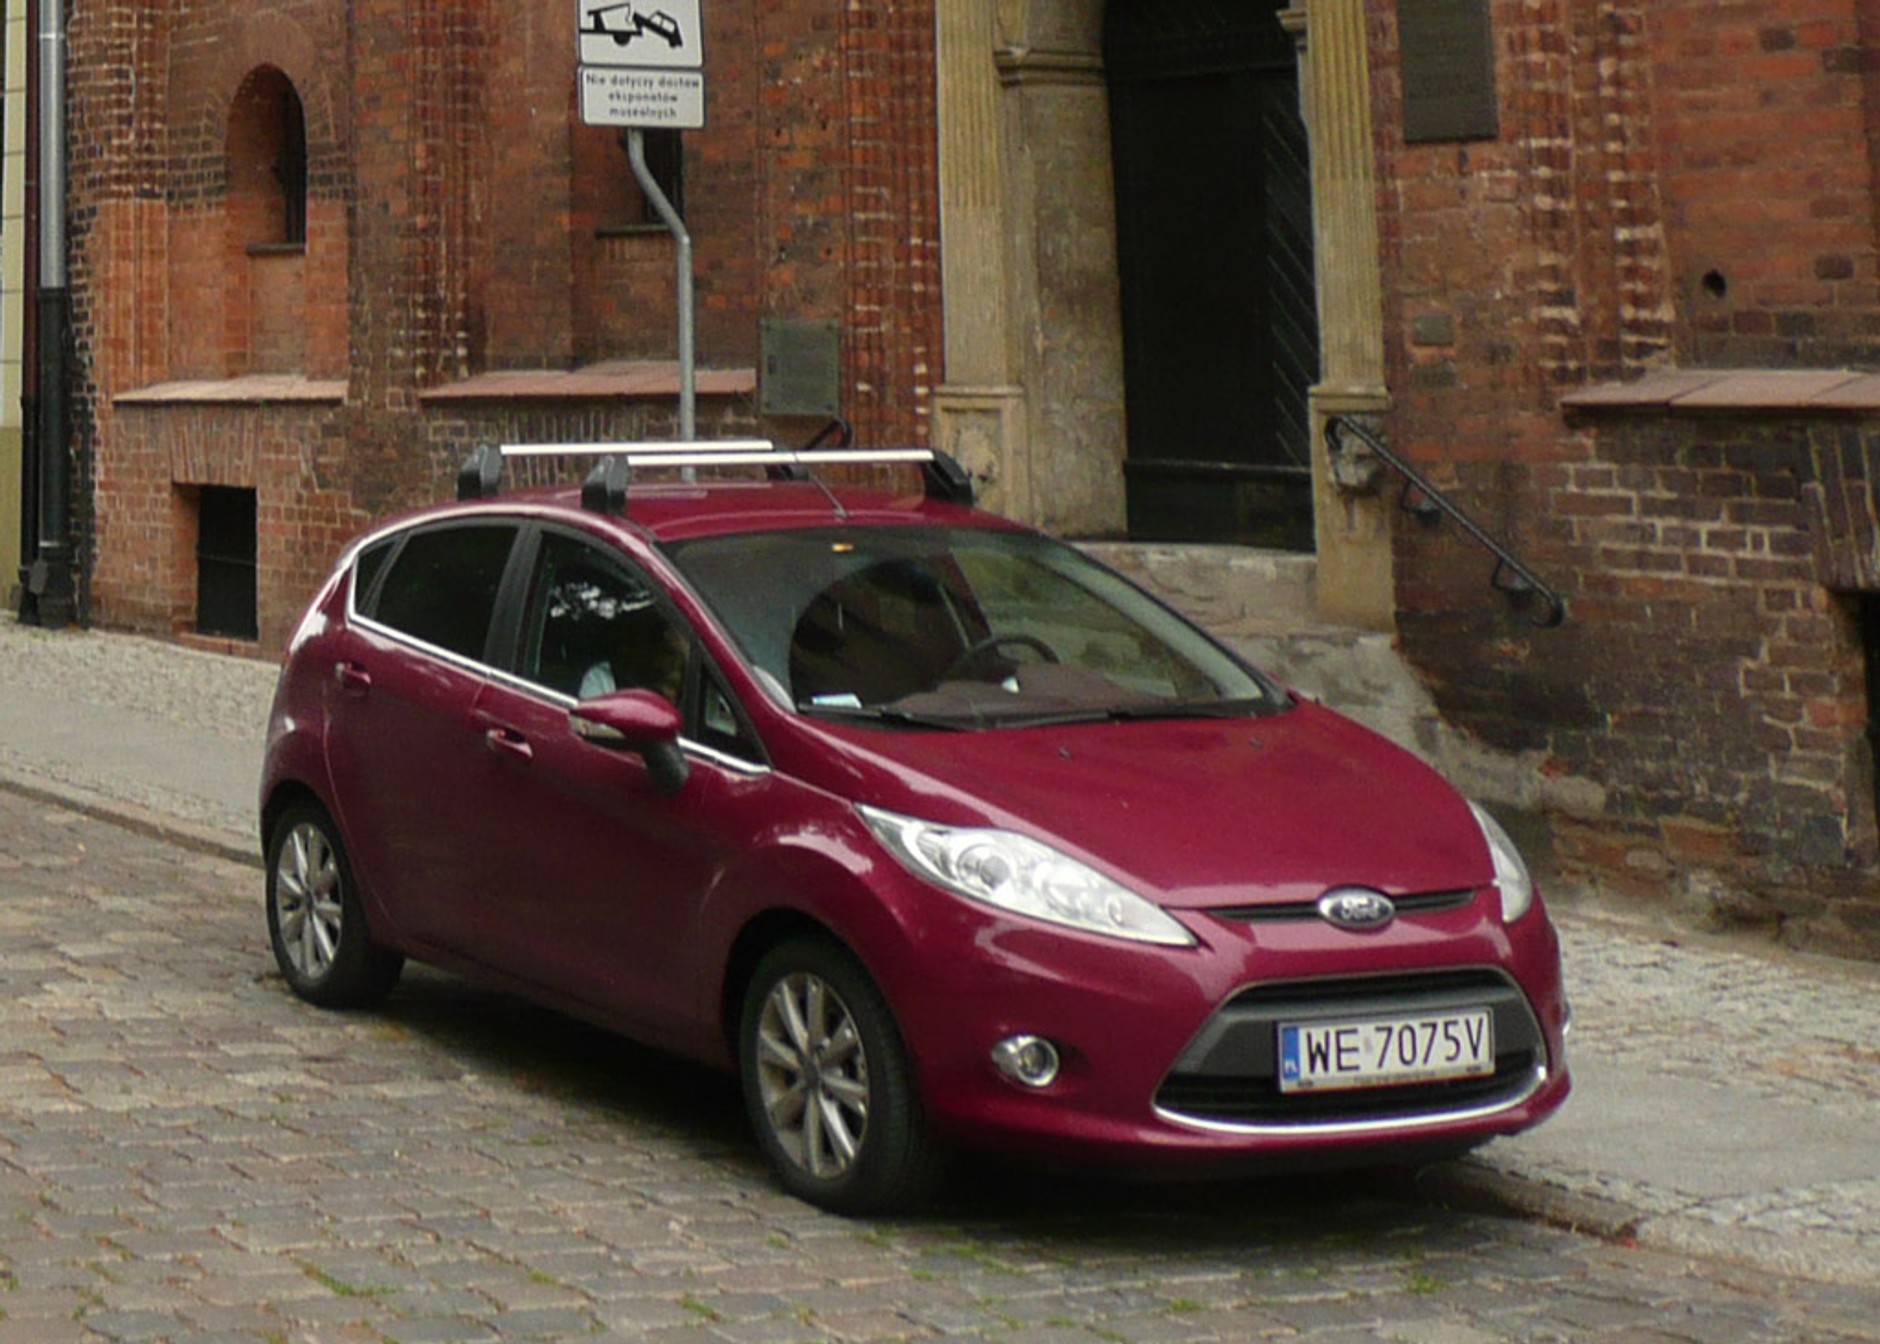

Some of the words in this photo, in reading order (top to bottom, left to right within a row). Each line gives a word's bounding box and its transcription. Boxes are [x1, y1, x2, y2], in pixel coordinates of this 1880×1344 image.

[586, 73, 605, 84] Nie
[1306, 1027, 1360, 1074] WE
[1374, 1016, 1484, 1069] 7075V
